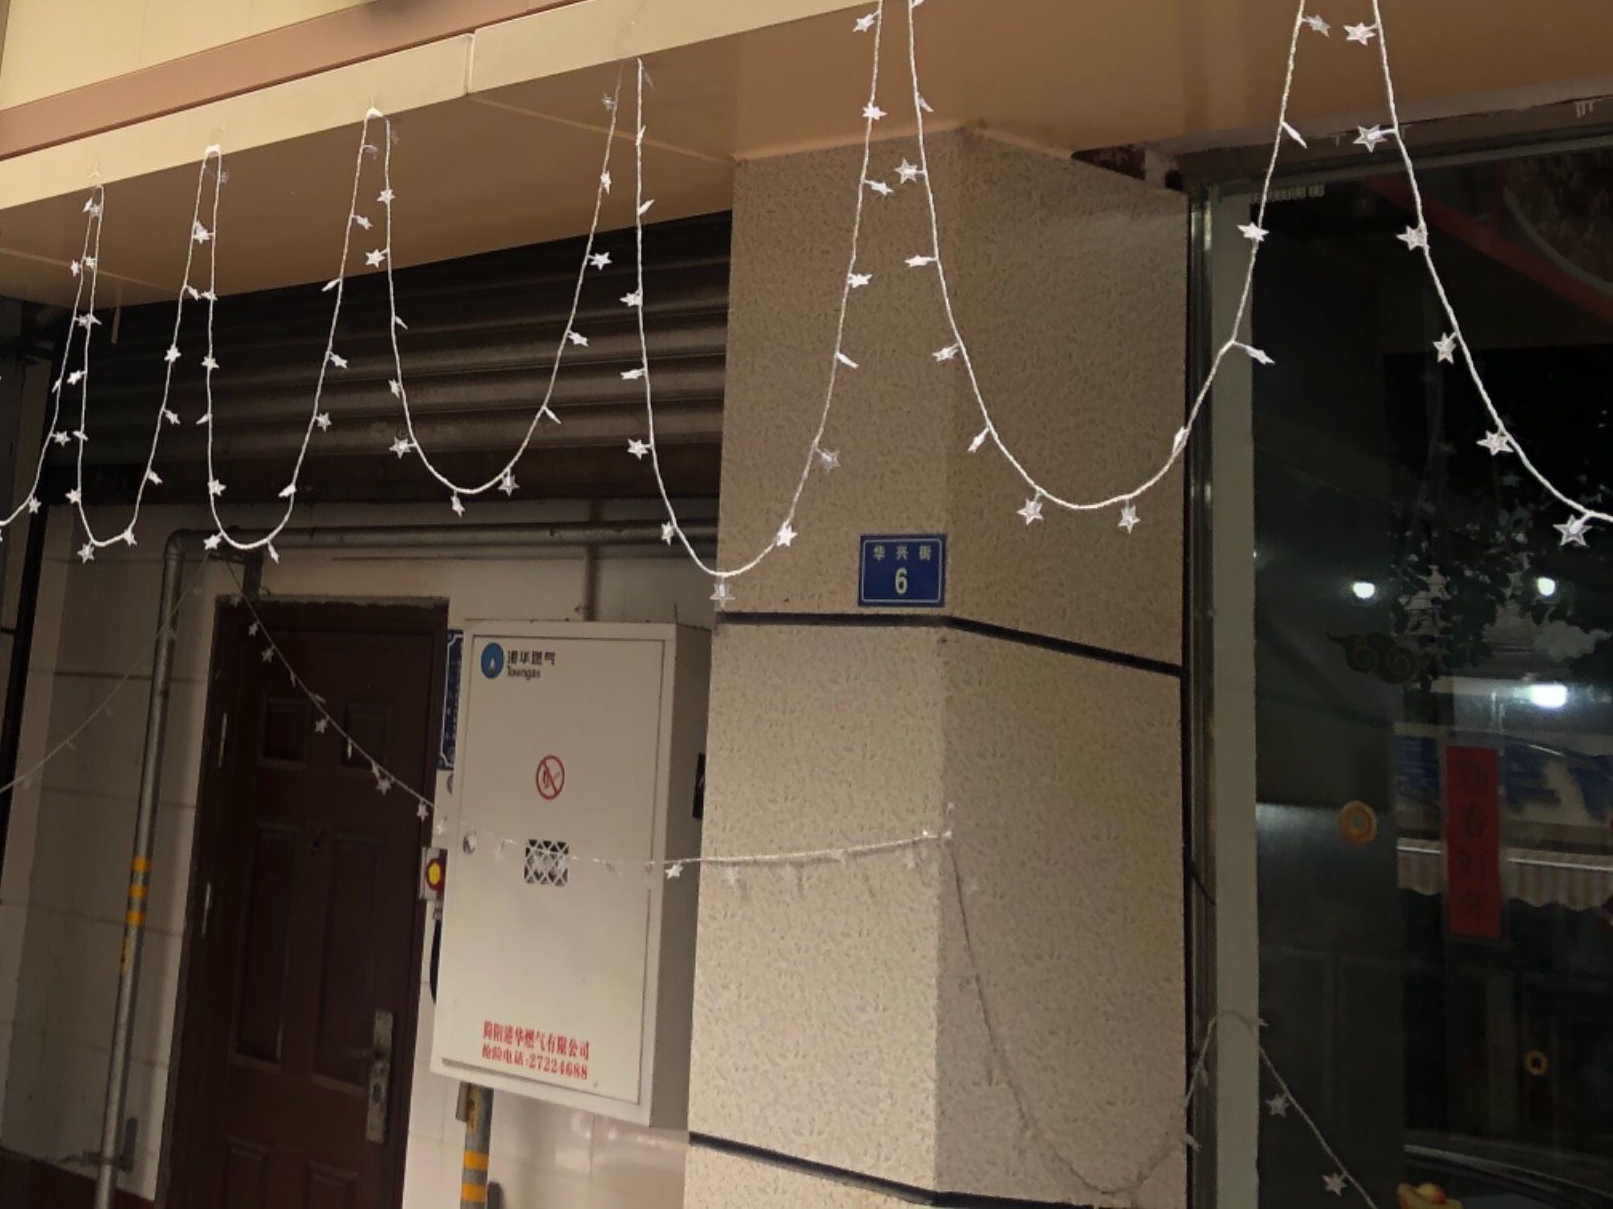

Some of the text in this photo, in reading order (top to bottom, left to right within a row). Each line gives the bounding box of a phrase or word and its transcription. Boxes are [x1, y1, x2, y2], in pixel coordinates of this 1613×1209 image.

[873, 545, 932, 561] 华兴街
[895, 566, 908, 595] 6
